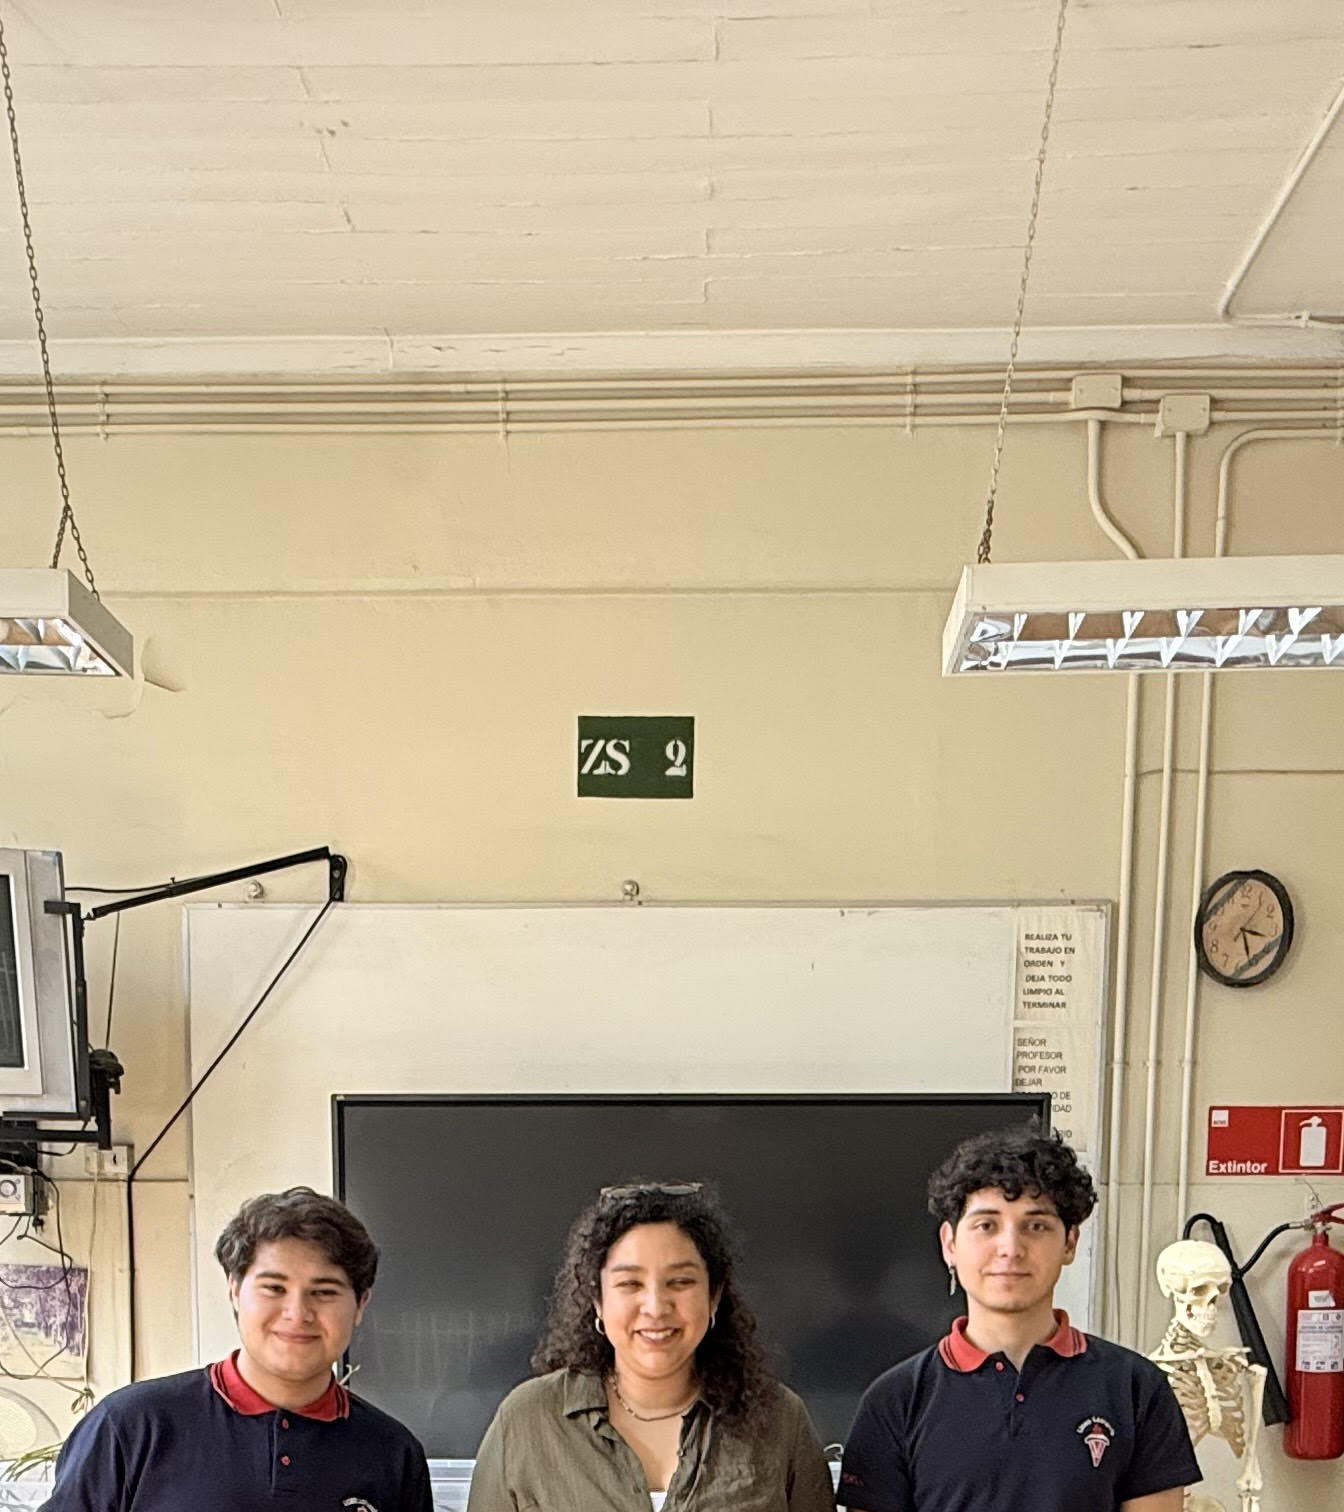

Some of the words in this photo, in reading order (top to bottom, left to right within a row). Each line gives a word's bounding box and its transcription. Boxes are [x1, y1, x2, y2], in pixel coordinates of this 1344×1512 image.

[580, 738, 631, 776] ZS
[664, 738, 687, 777] 2
[1024, 933, 1059, 941] REALIZA
[1060, 933, 1073, 941] TU
[1024, 946, 1063, 954] TRABAJO
[1064, 946, 1075, 954] EN
[1023, 960, 1054, 968] ORDEN
[1025, 974, 1046, 983] DEJA
[1047, 974, 1073, 983] TODO
[1022, 988, 1053, 996] LIMPIO
[1054, 988, 1065, 996] AL
[1022, 1001, 1067, 1009] TERMINAR
[1016, 1037, 1047, 1047] SEÑOR
[1016, 1051, 1063, 1060] PROFESOR
[1017, 1065, 1037, 1074] POR
[1038, 1065, 1067, 1074] FAVOR
[1015, 1078, 1043, 1087] DEJAR
[1059, 1091, 1072, 1100] DE
[1208, 1159, 1268, 1174] Extintor
